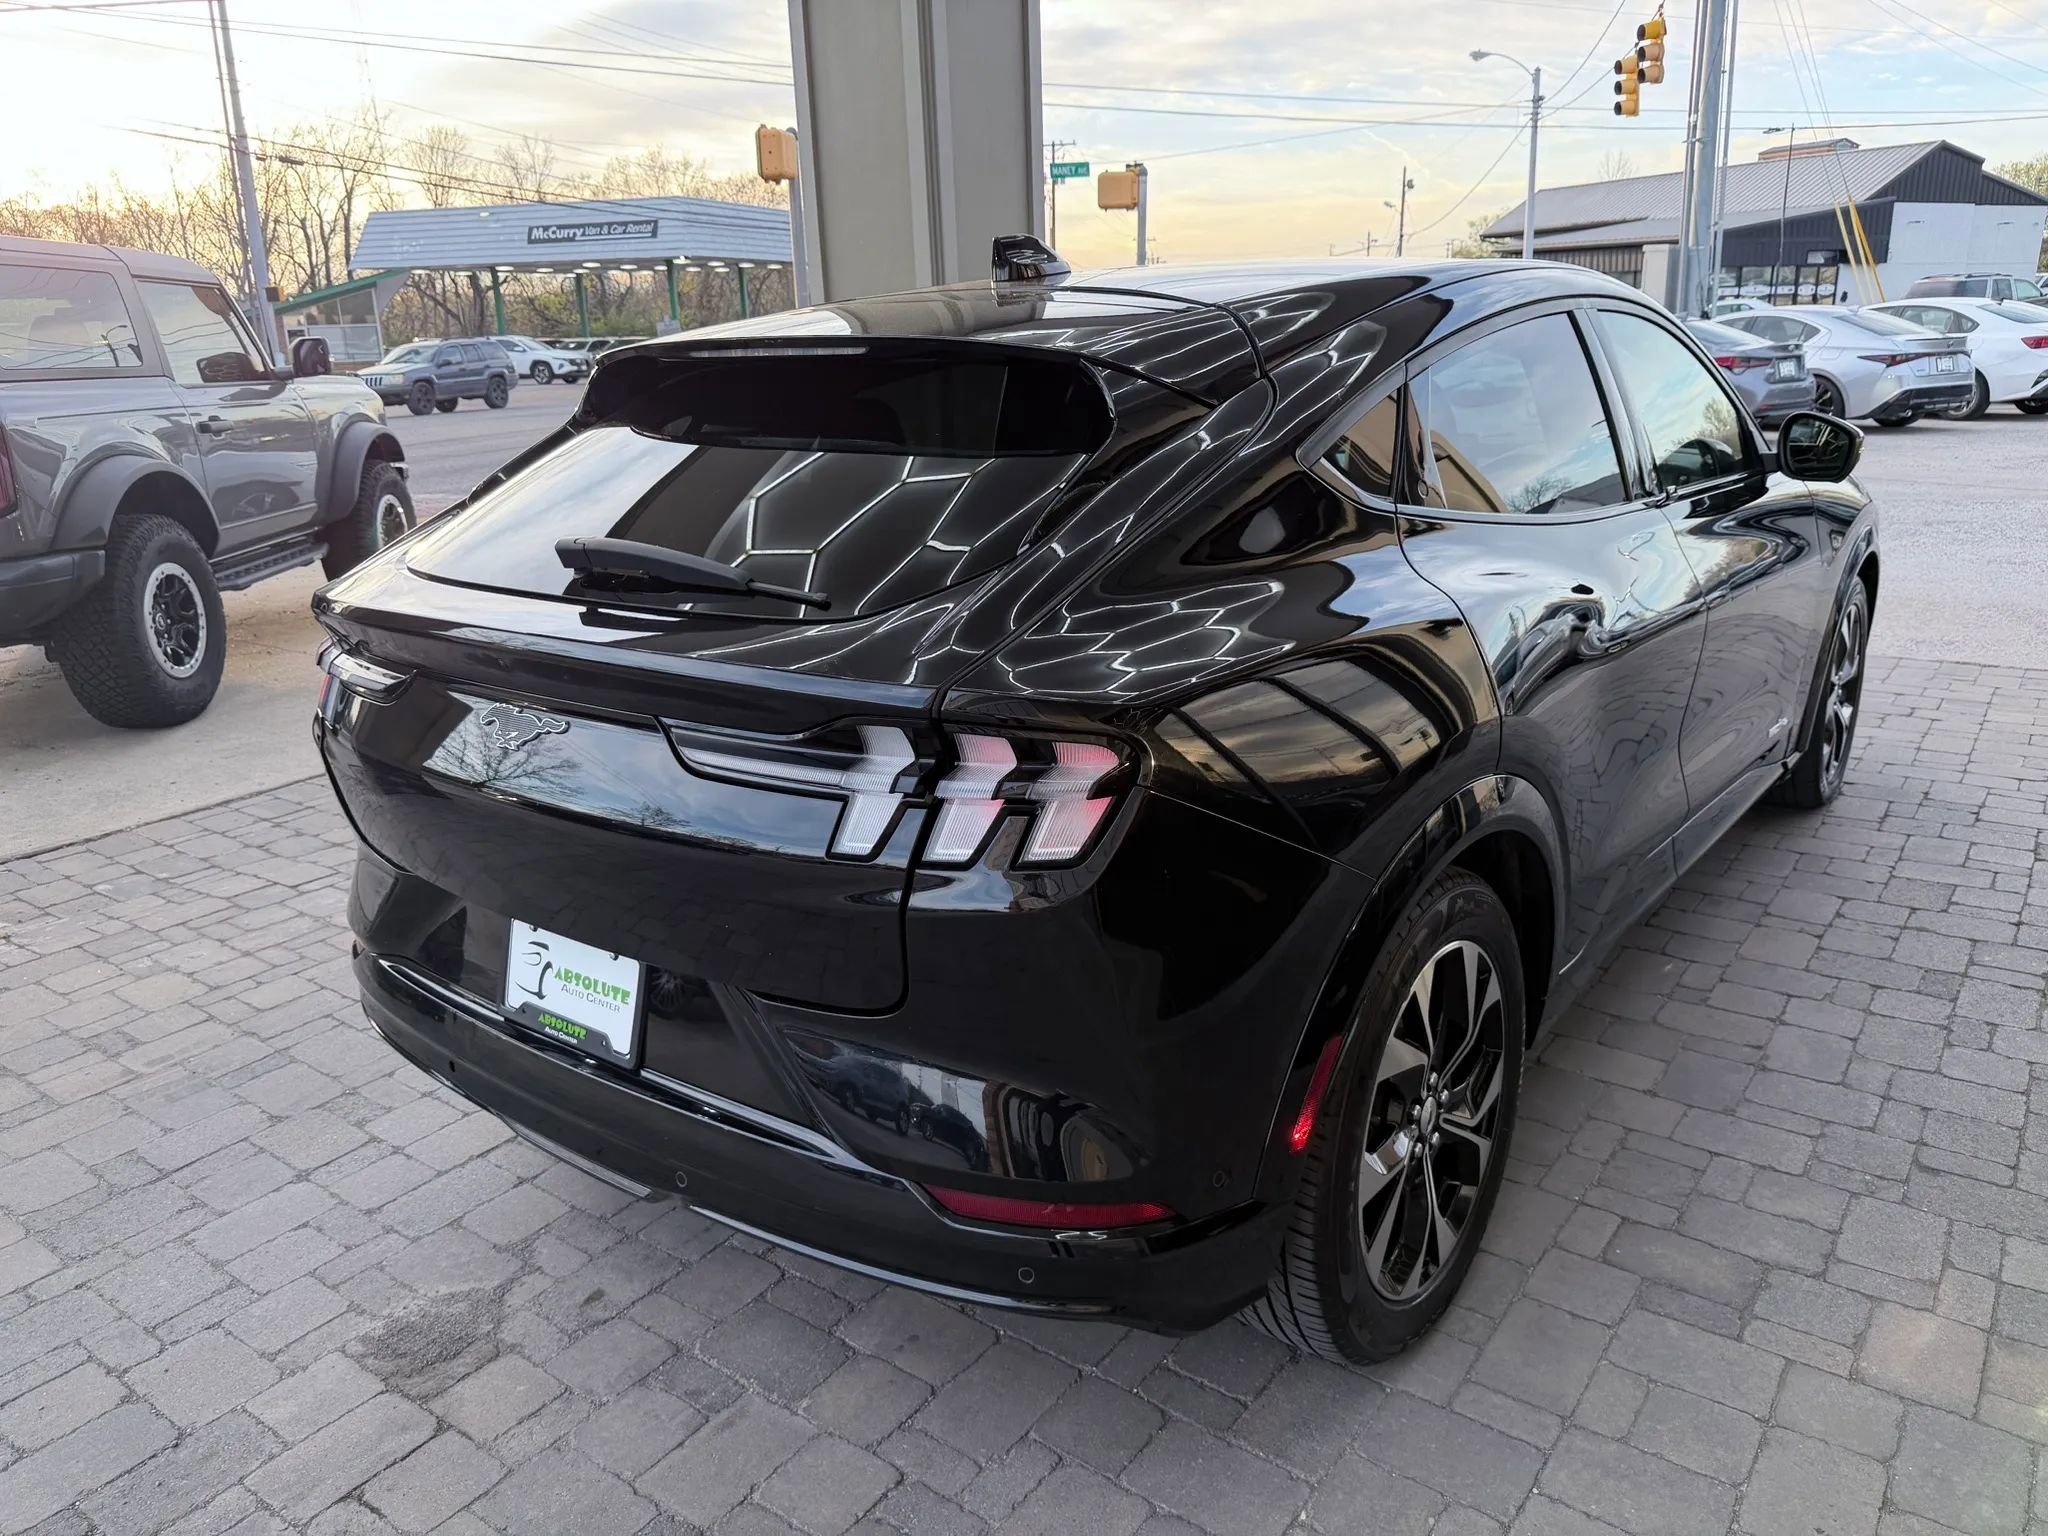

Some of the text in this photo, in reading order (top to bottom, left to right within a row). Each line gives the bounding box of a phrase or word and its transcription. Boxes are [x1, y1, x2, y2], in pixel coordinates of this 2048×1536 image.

[531, 222, 654, 240] McCurry Van & Car Rental
[554, 967, 631, 1005] ABSOLUTE
[538, 1013, 588, 1040] ABSOLUTE
